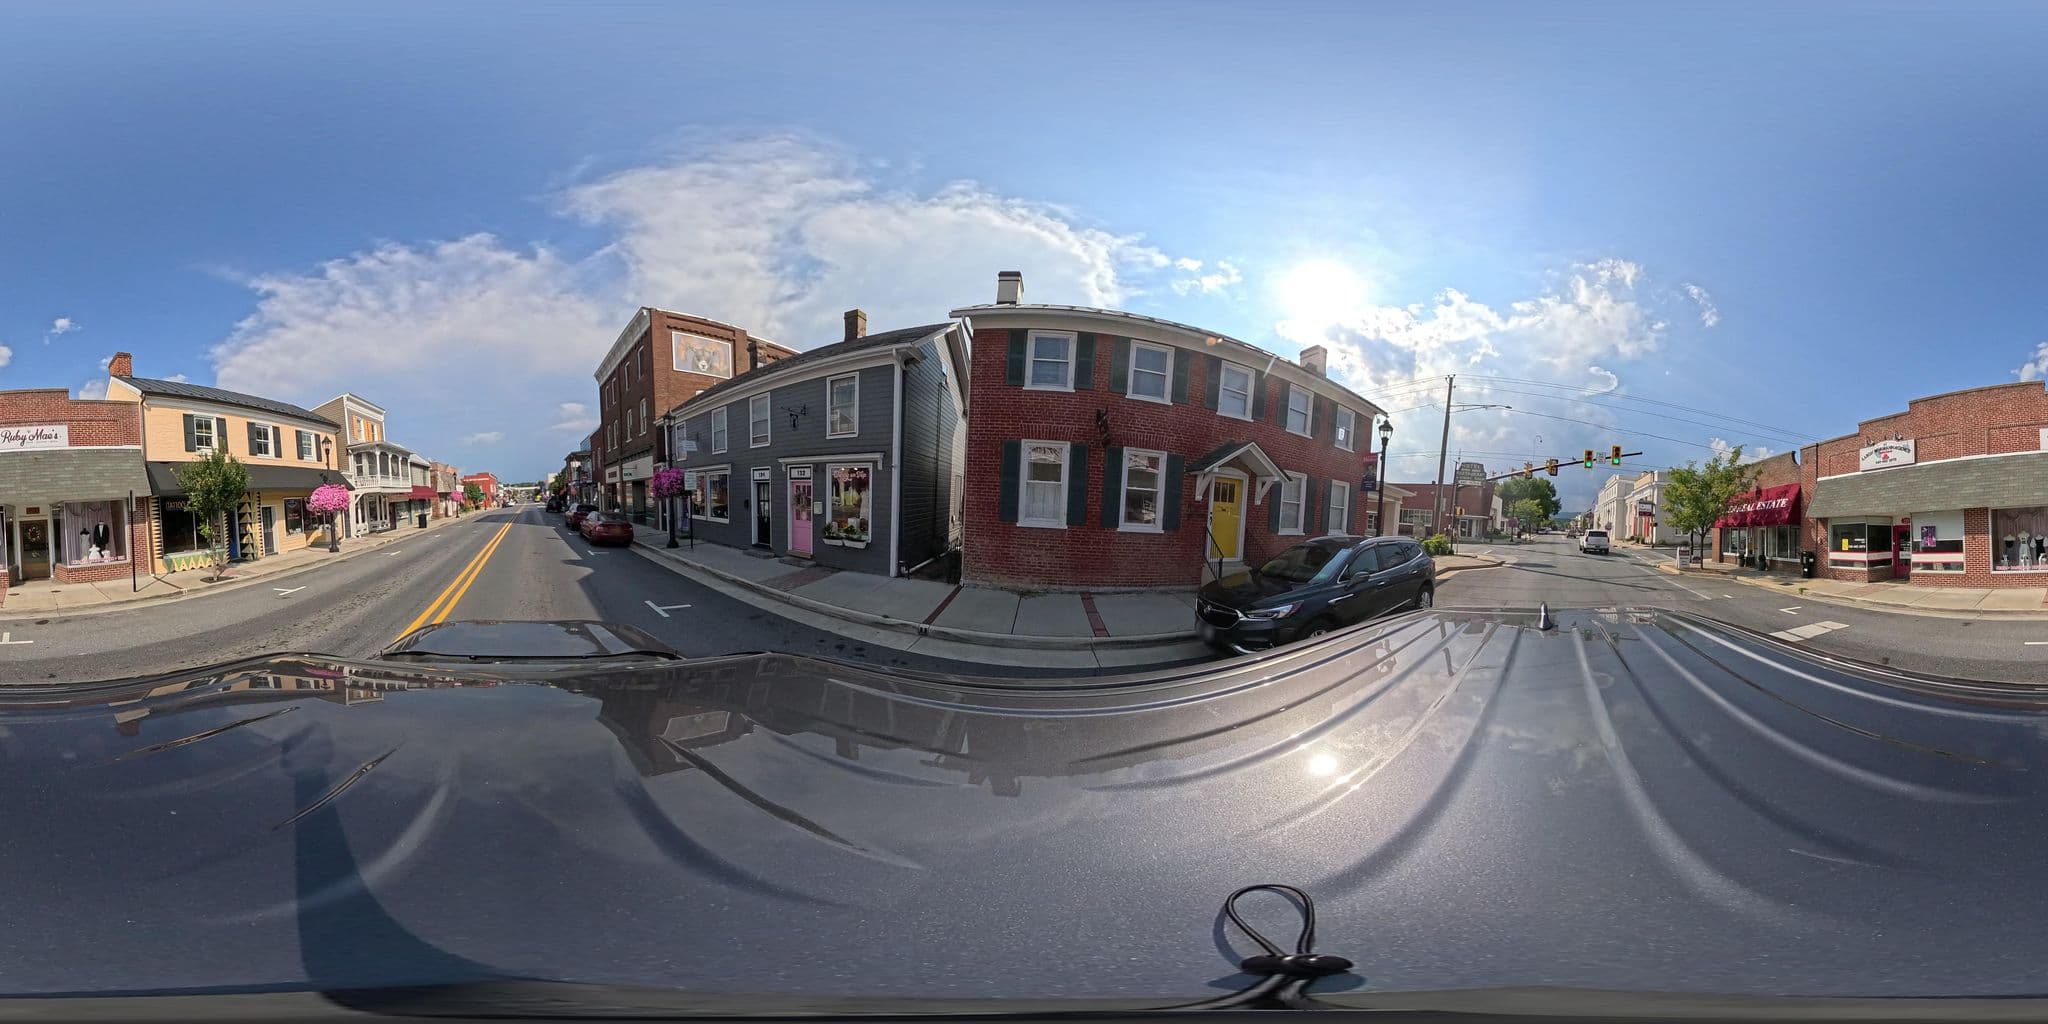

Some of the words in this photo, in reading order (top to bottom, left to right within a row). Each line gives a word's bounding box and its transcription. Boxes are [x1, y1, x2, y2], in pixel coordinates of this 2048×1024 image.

[1, 430, 27, 446] Ruby
[28, 428, 58, 441] Mae's
[1756, 498, 1788, 510] ESTATE
